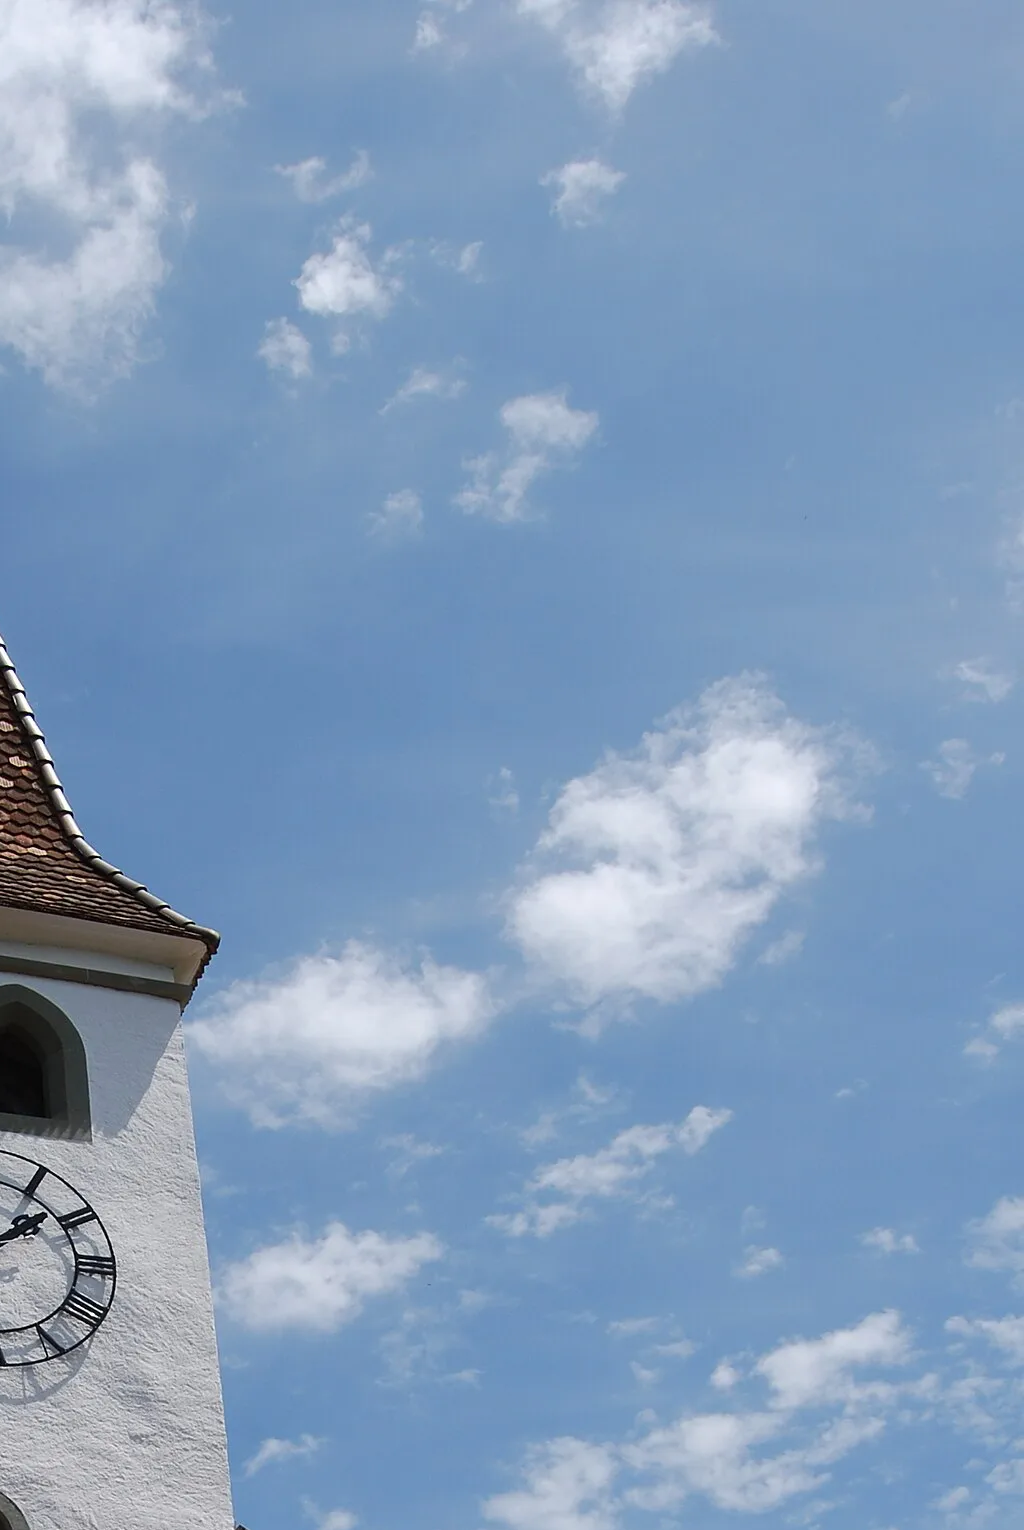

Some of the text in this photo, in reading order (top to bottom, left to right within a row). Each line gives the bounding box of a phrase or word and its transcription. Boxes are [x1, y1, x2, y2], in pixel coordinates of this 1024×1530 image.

[25, 1166, 48, 1196] I
[58, 1206, 97, 1229] II
[77, 1255, 115, 1275] III
[63, 1289, 107, 1327] IIII
[36, 1324, 66, 1358] V
